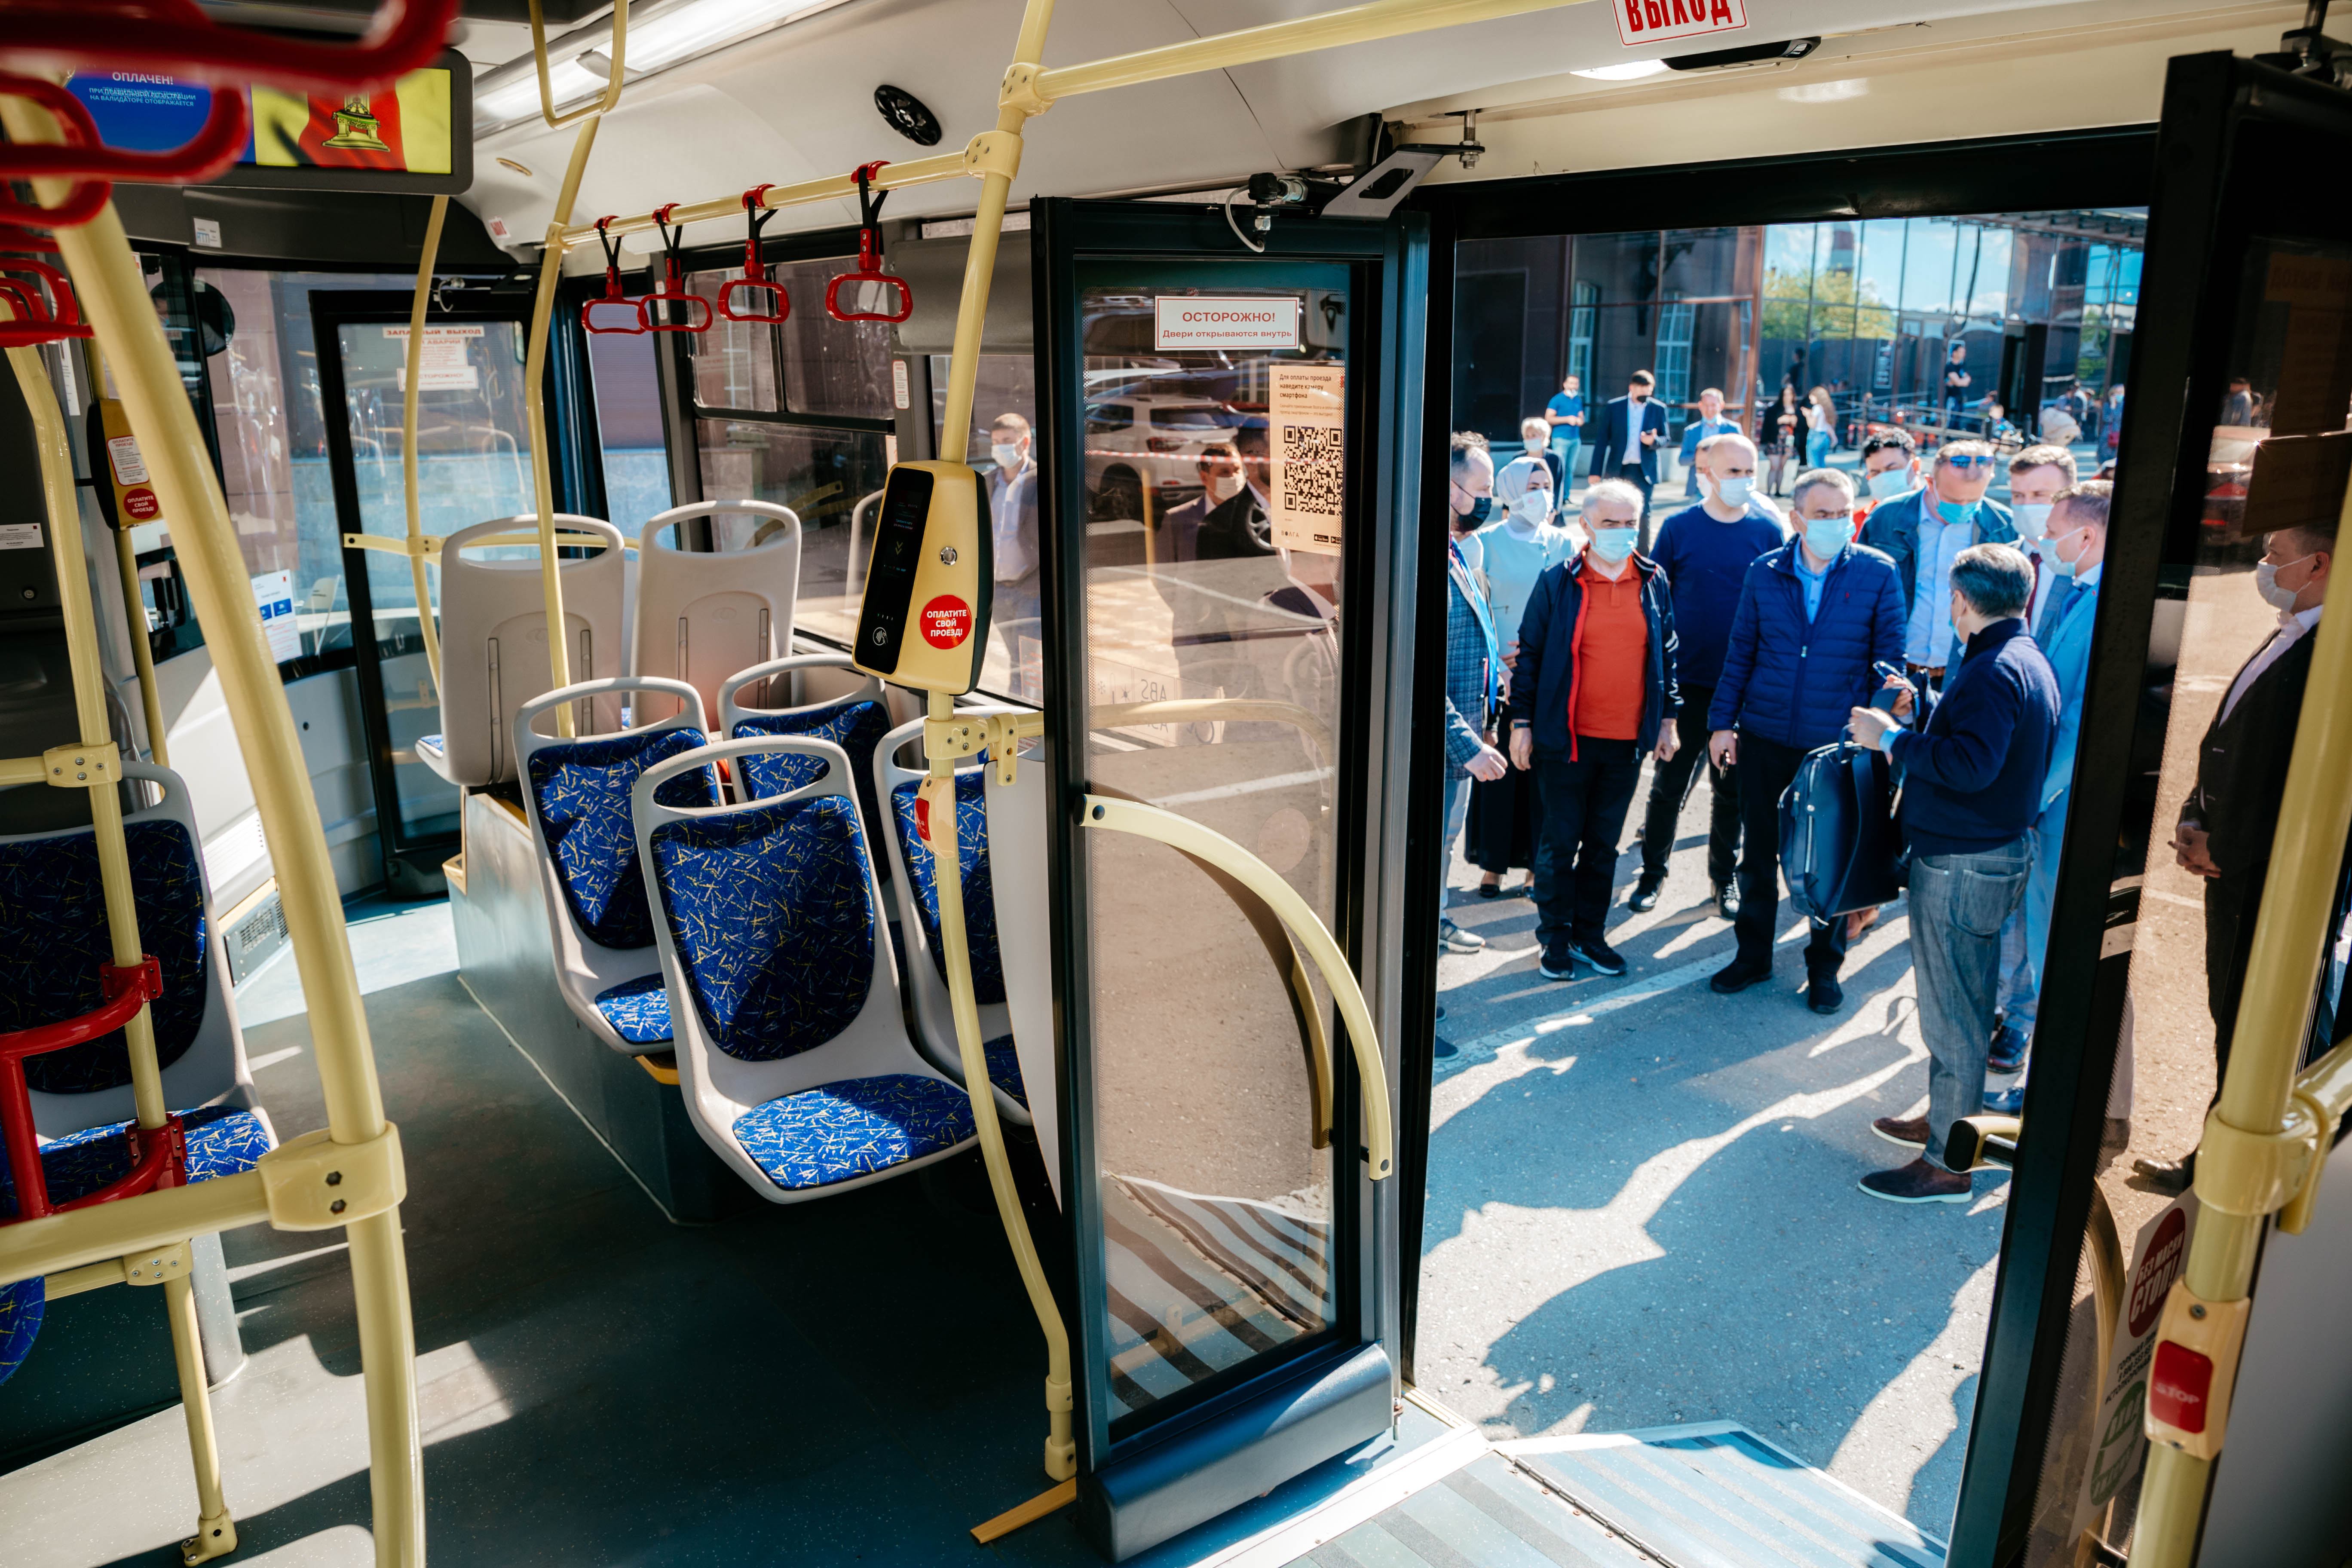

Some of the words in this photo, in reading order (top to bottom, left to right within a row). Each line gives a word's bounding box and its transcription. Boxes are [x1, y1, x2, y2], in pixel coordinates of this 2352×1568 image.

[112, 72, 174, 85] ОПЛАЧЕН!
[101, 95, 144, 103] ВАЛИДАТОРЕ
[145, 98, 194, 107] ОТОБРАЖАЕТСЯ
[1182, 312, 1275, 322] ОСТОРОЖНО!
[1163, 330, 1193, 339] Двери
[127, 495, 154, 503] ОПЛАТИТЕ
[927, 609, 967, 618] ОПЛАТИТЕ
[936, 618, 956, 627] СВОЙ
[931, 628, 963, 637] ПРОЕЗД!
[2136, 1256, 2155, 1286] БЕЗ
[2153, 1230, 2184, 1271] МАСКИ
[2130, 1253, 2178, 1323] СТОП!
[2155, 1382, 2200, 1404] STOP
